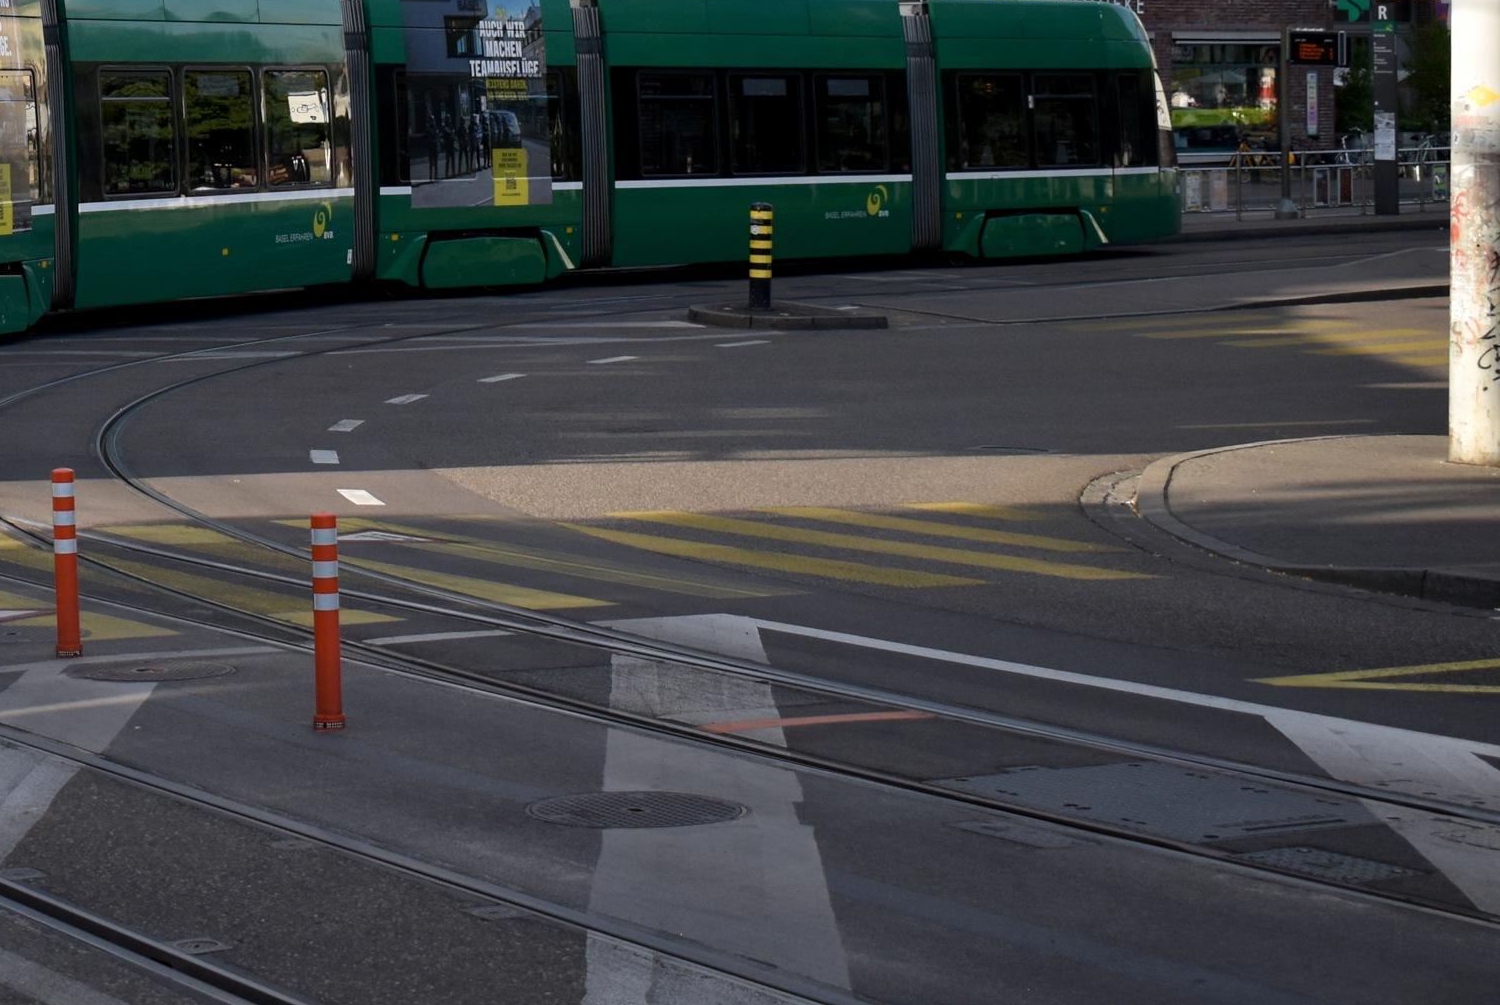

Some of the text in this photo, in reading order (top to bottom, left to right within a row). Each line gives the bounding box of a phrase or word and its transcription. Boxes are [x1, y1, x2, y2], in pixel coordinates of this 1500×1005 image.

[1377, 5, 1388, 20] R
[479, 20, 526, 38] AUCH WIR
[485, 40, 522, 58] MACHEN
[469, 58, 542, 78] TEAMAUSFLÜGE.
[323, 231, 333, 239] BVB
